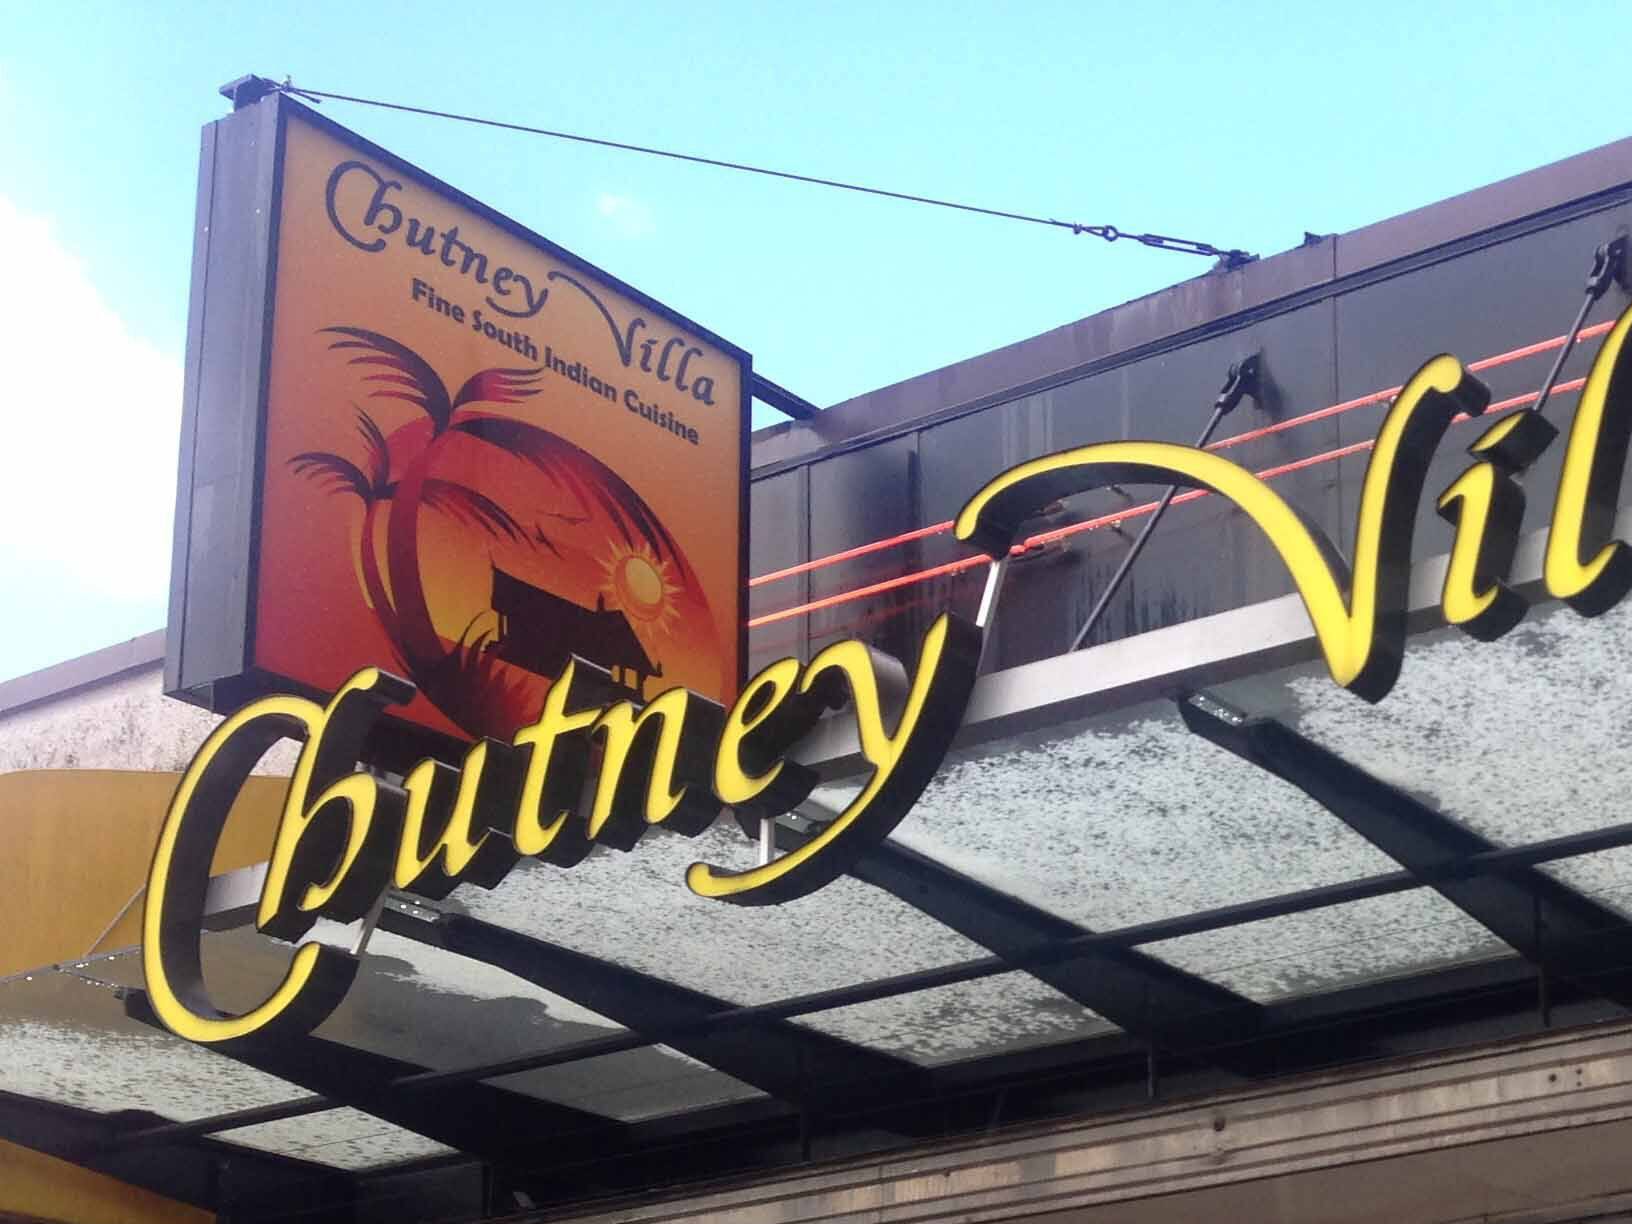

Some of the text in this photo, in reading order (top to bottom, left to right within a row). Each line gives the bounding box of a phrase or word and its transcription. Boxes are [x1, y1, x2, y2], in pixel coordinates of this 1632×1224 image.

[326, 161, 716, 406] Chutney Villa
[412, 278, 700, 445] Fine South Indian Cuisine
[143, 611, 975, 1044] Chutney
